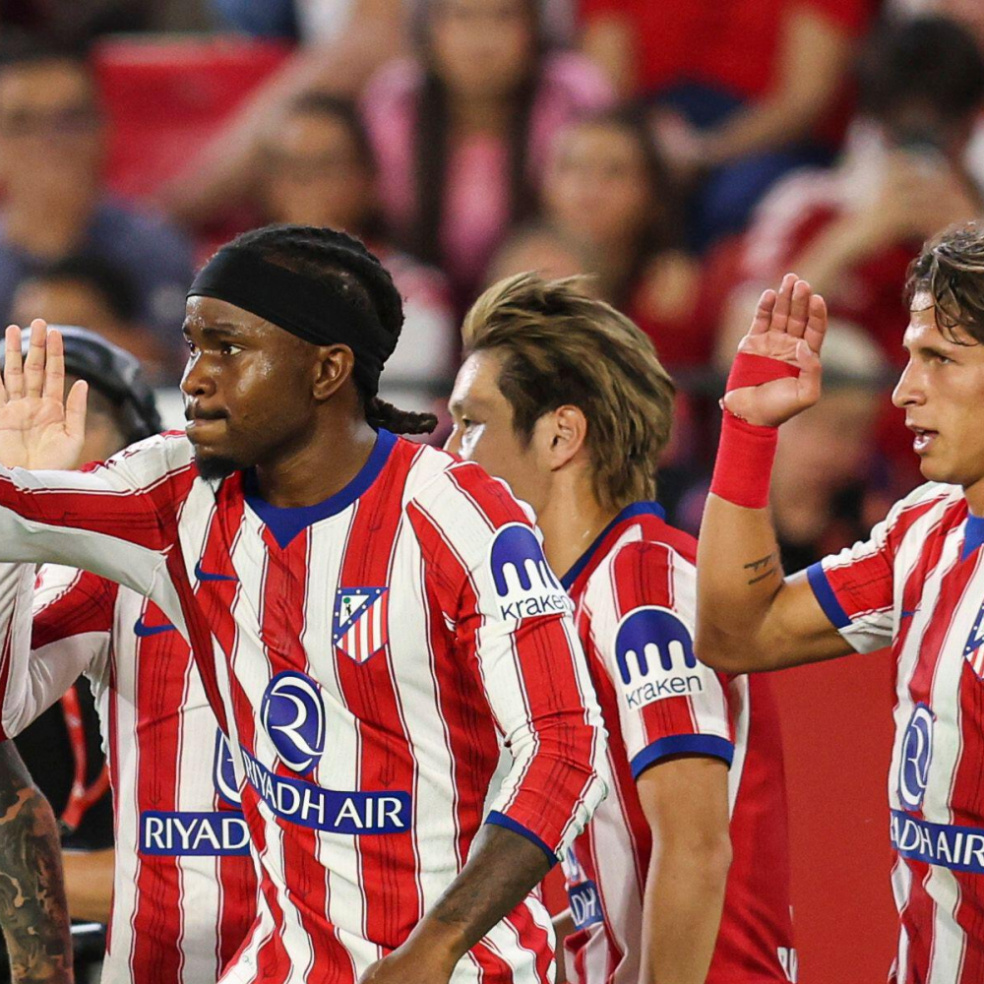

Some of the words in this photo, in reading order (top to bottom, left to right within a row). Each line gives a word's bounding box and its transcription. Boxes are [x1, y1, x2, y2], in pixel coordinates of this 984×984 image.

[500, 594, 570, 621] kraken
[625, 675, 703, 710] kraken
[242, 748, 325, 825] RIYADH
[334, 796, 405, 829] AIR
[144, 816, 251, 850] RIYAD
[937, 831, 984, 868] AIR
